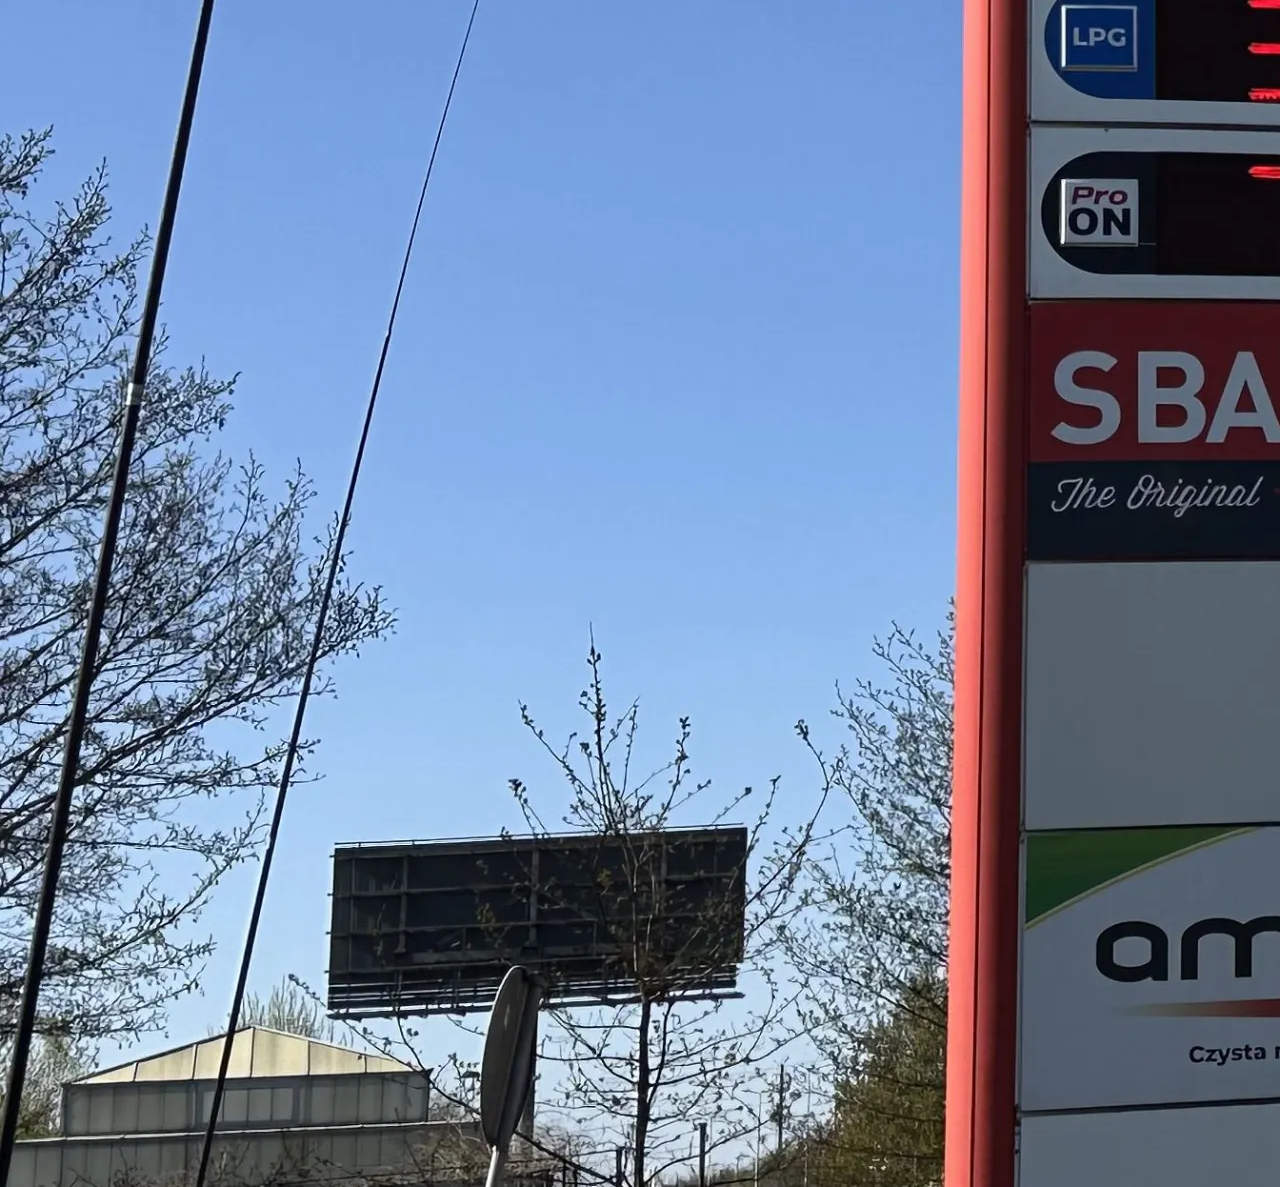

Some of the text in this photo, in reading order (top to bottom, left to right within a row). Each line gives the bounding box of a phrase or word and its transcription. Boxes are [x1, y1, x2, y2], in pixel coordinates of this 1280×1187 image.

[1072, 27, 1127, 50] LPG
[1071, 186, 1128, 205] Pro
[1068, 207, 1131, 236] ON
[1050, 477, 1115, 511] The
[1126, 474, 1264, 518] Original
[1189, 1041, 1267, 1067] Czysta
